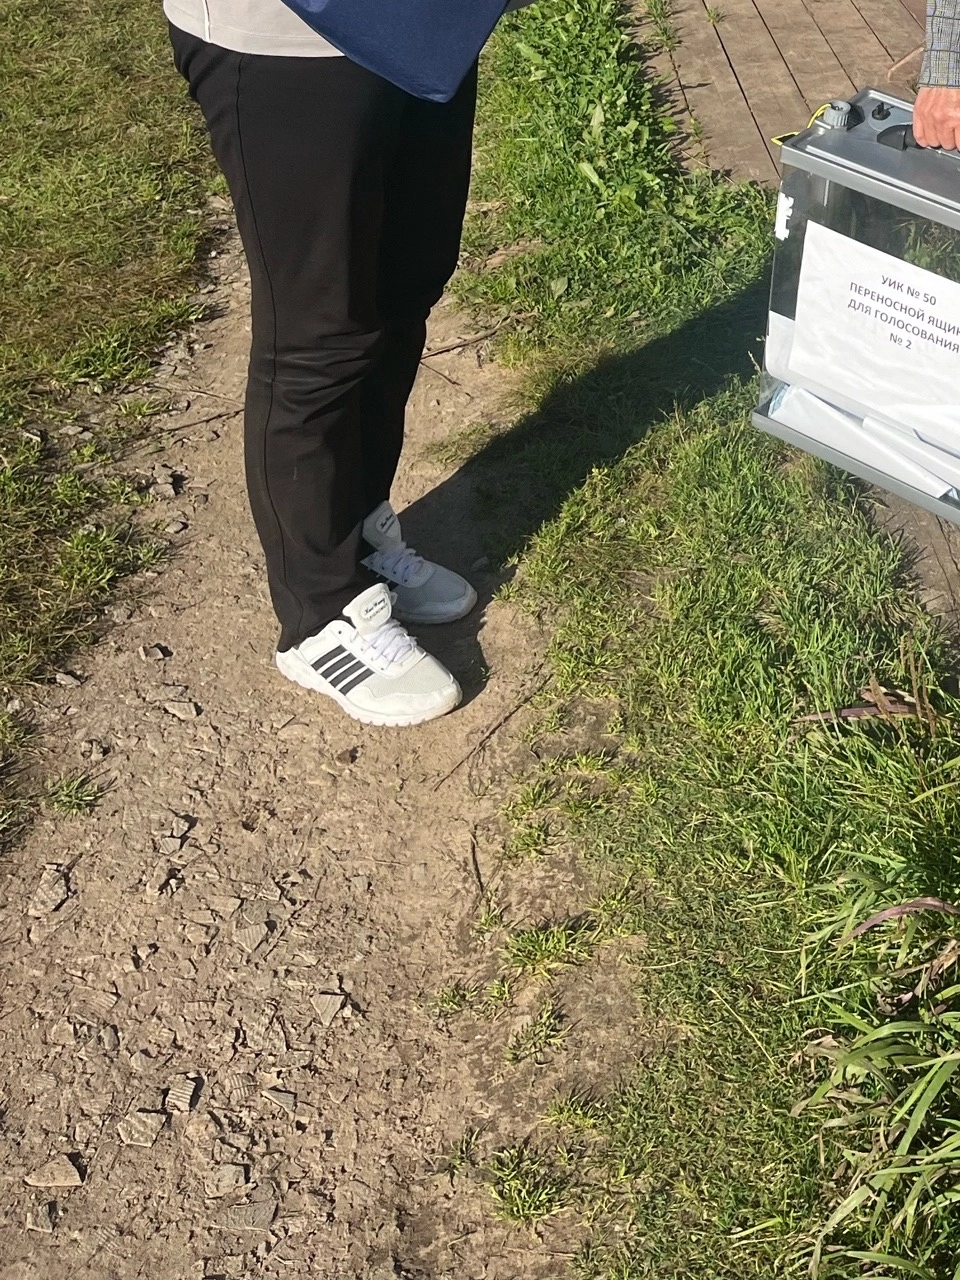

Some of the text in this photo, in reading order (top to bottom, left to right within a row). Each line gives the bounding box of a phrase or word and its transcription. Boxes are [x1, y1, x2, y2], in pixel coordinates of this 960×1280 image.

[849, 281, 925, 322] ПЕРЕНОСНОЙ
[881, 274, 937, 306] УИК № 50
[847, 298, 960, 354] ДЛЯ ГОЛОСОВАНИЯ
[889, 332, 912, 350] № 2
